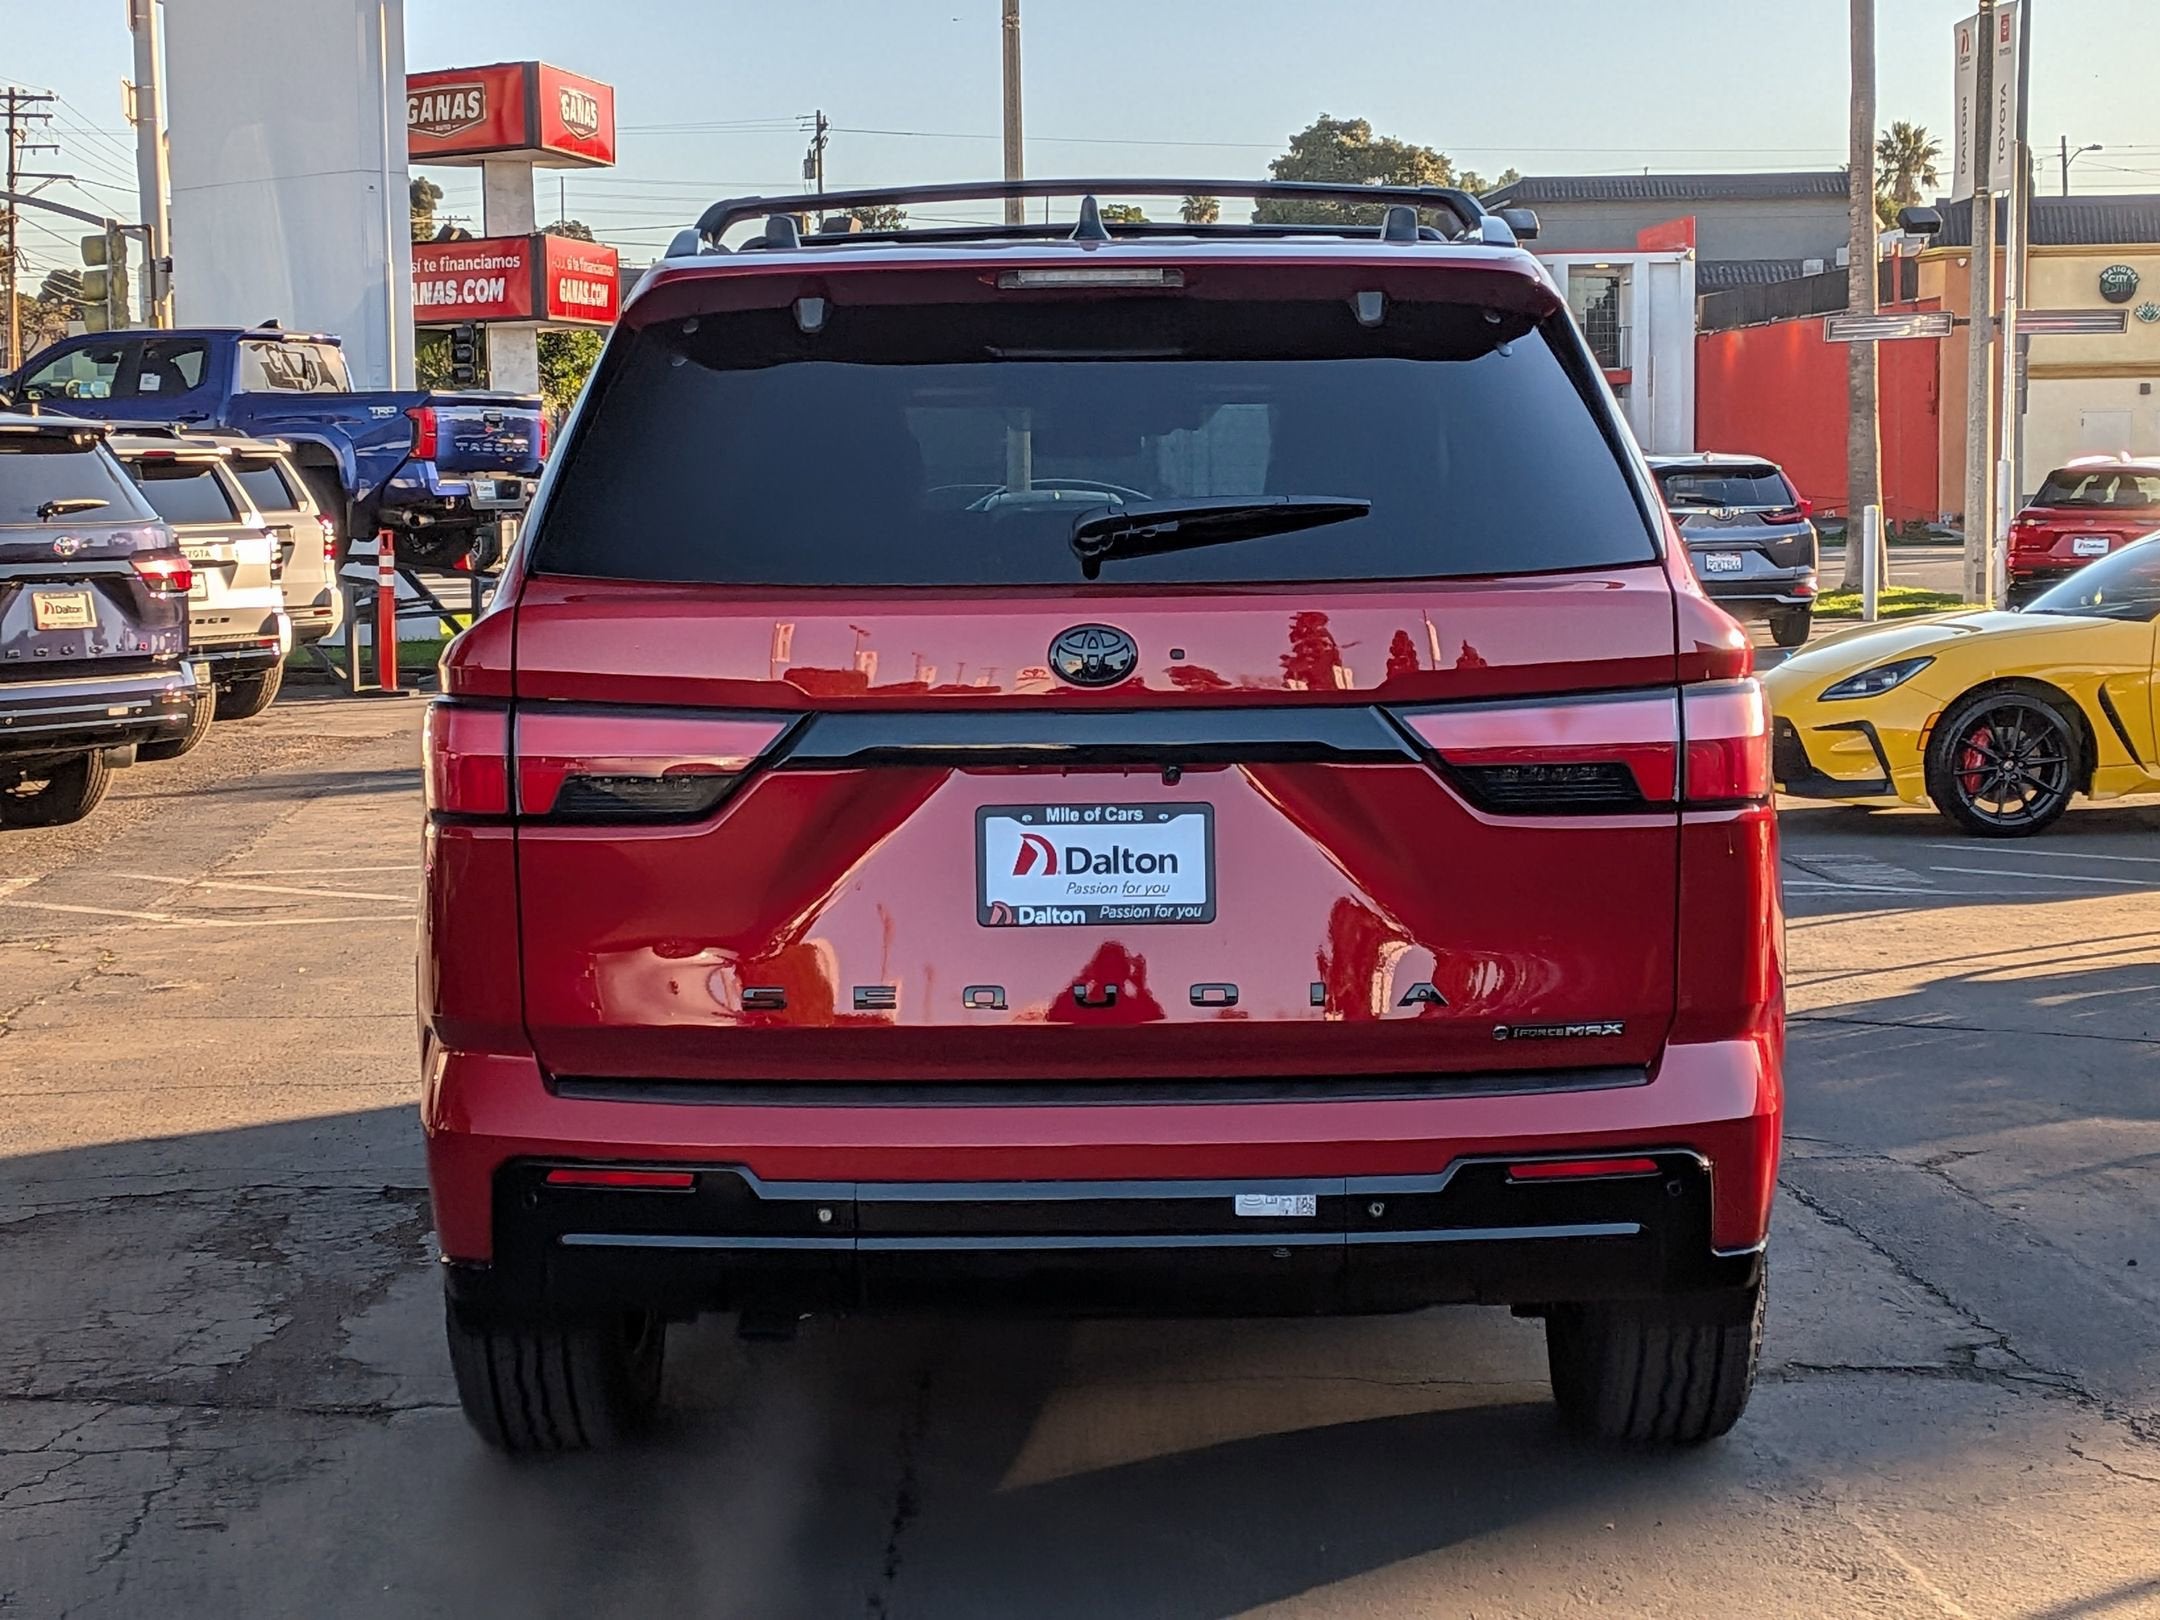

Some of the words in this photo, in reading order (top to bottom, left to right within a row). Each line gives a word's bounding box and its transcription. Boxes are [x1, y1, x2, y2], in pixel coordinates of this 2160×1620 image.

[407, 90, 481, 124] GANAS
[561, 93, 598, 129] GANAS
[1998, 84, 2006, 164] TOYOTA
[424, 259, 436, 272] te
[440, 254, 520, 272] financiamos
[2101, 266, 2139, 283] NATIONAL
[2108, 274, 2128, 283] CITY
[560, 277, 608, 307] GANAS.COM
[368, 406, 397, 415] TRD
[55, 604, 82, 614] Dalton
[1046, 807, 1079, 822] Mile
[1084, 807, 1101, 821] of
[1105, 807, 1144, 822] Cars
[1065, 845, 1178, 875] Dalton
[1066, 881, 1118, 895] Passion
[1122, 880, 1142, 896] for
[1144, 884, 1170, 896] you
[1018, 906, 1086, 925] Dalton
[1100, 905, 1150, 919] Passion
[1154, 904, 1174, 917] for
[1176, 908, 1203, 920] you
[742, 981, 1449, 1011] SEQUOIA
